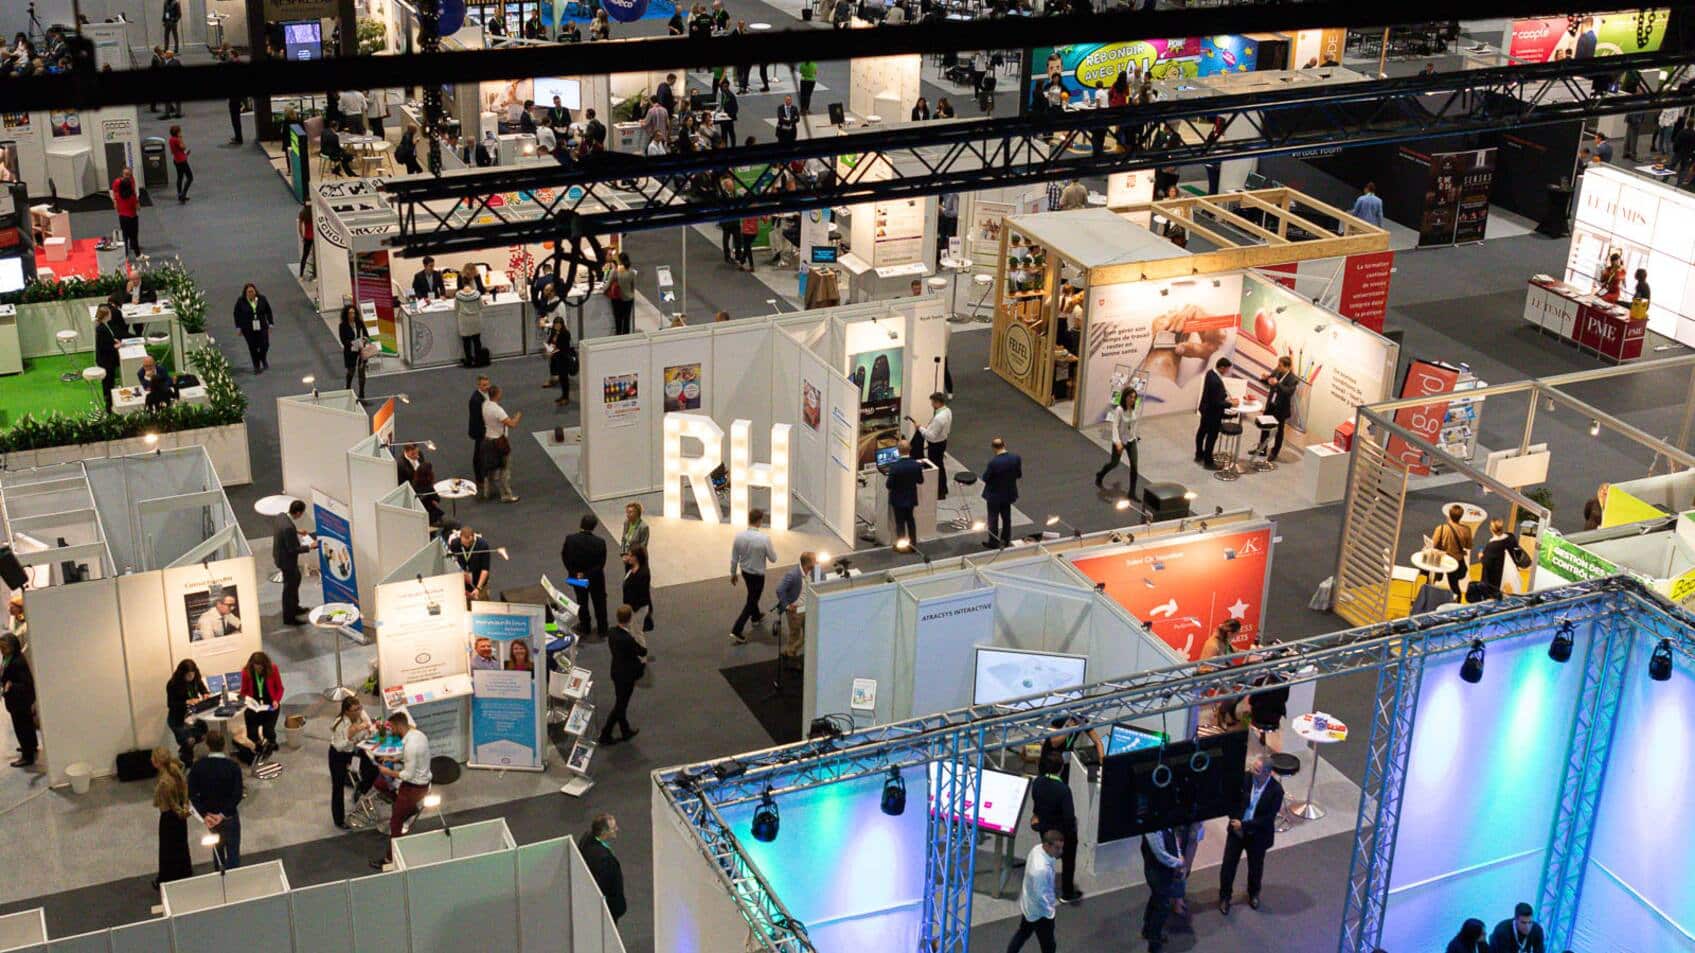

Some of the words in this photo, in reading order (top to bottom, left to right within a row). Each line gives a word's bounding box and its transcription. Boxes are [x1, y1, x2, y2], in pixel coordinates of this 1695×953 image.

[1086, 45, 1146, 66] REBONDIR
[1085, 66, 1114, 80] AVEC
[1531, 298, 1540, 309] LE
[1543, 305, 1572, 321] TEMPS
[1587, 316, 1617, 341] PME
[1628, 327, 1642, 336] PME
[1009, 336, 1028, 360] FELFEL
[663, 411, 792, 530] RH
[1553, 546, 1589, 570] GESTION
[920, 611, 953, 621] ATRACSYS
[953, 603, 992, 616] INTERACTIVE
